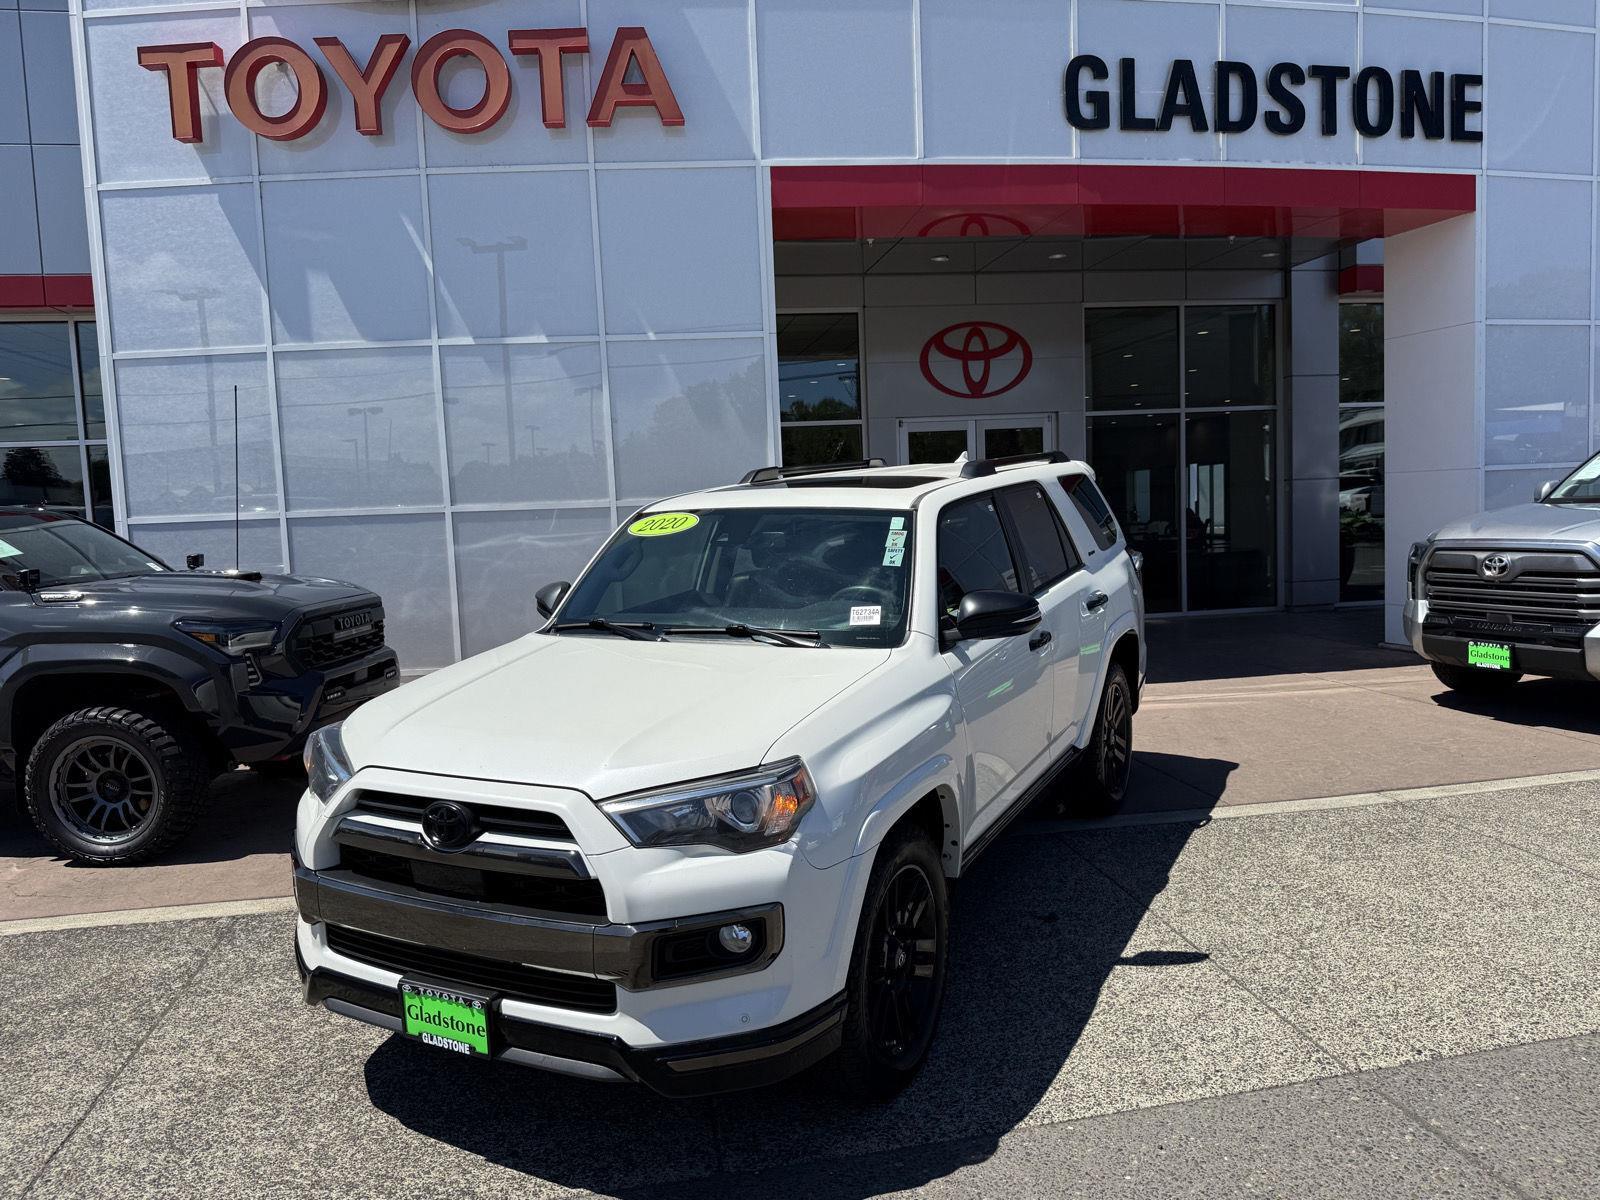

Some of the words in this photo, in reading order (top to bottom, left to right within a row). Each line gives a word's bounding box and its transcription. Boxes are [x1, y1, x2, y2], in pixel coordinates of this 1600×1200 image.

[137, 26, 685, 144] TOYOTA
[1064, 54, 1484, 142] GLADSTONE
[637, 516, 689, 533] 2020
[336, 612, 371, 631] TOYOTA
[1470, 649, 1510, 662] Gladstone
[418, 987, 466, 1005] TOYOTA
[407, 1003, 486, 1038] Gladstone
[422, 1032, 471, 1055] GLADSTONE
